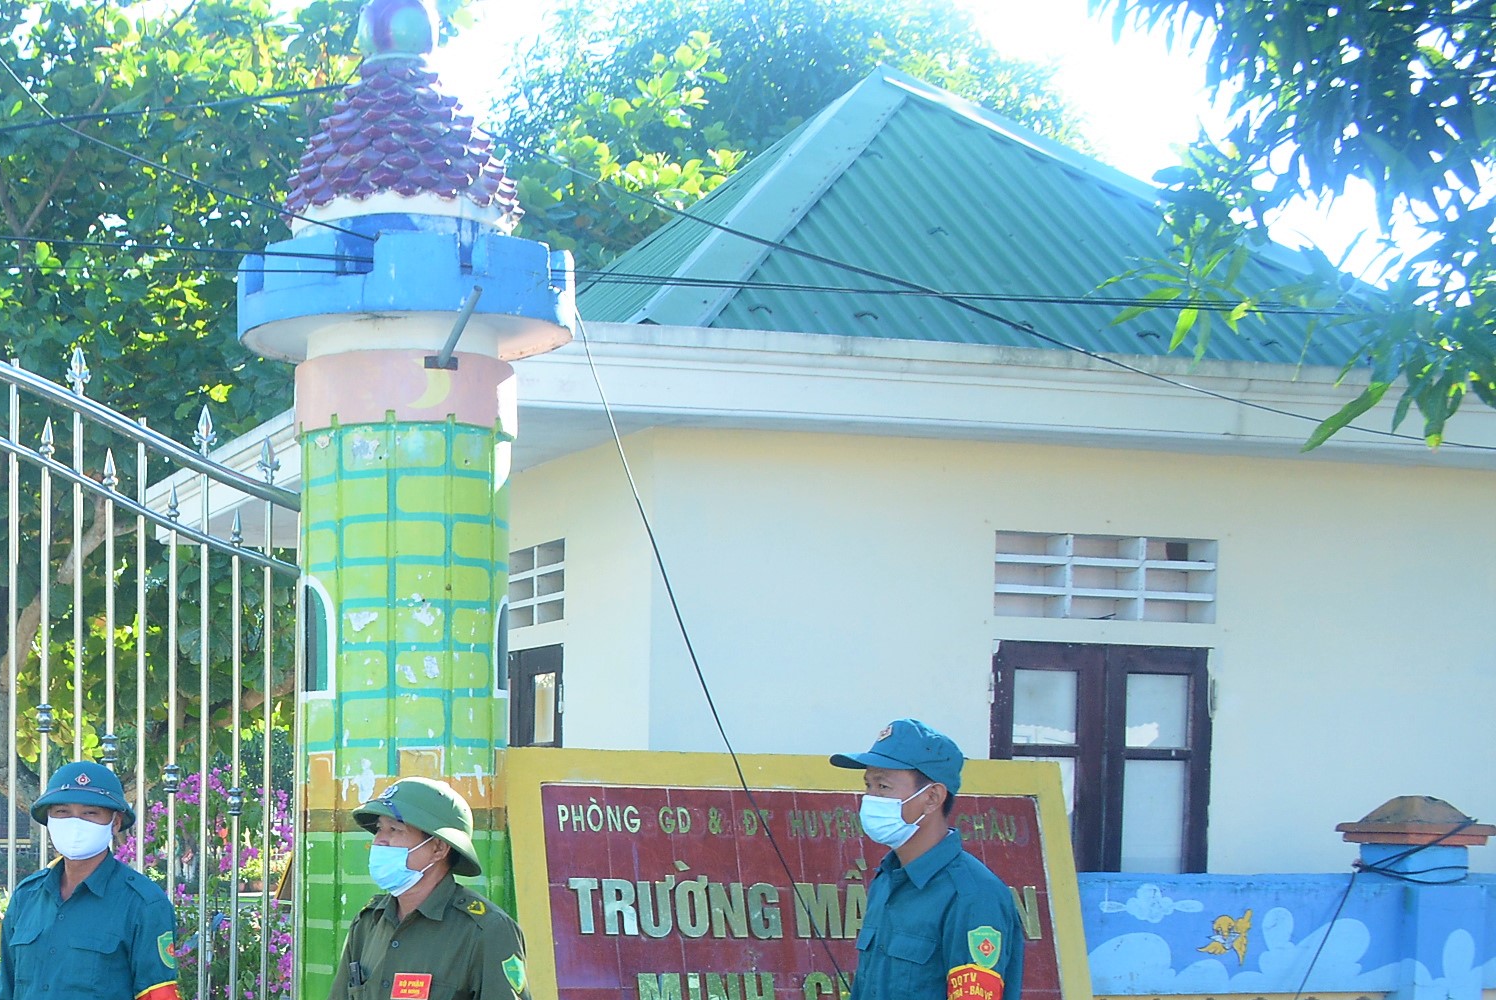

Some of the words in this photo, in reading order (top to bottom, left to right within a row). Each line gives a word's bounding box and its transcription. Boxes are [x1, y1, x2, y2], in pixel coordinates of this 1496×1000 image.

[557, 797, 641, 833] PHÒNG
[658, 805, 691, 834] GD
[568, 860, 783, 940] TRƯỜNG
